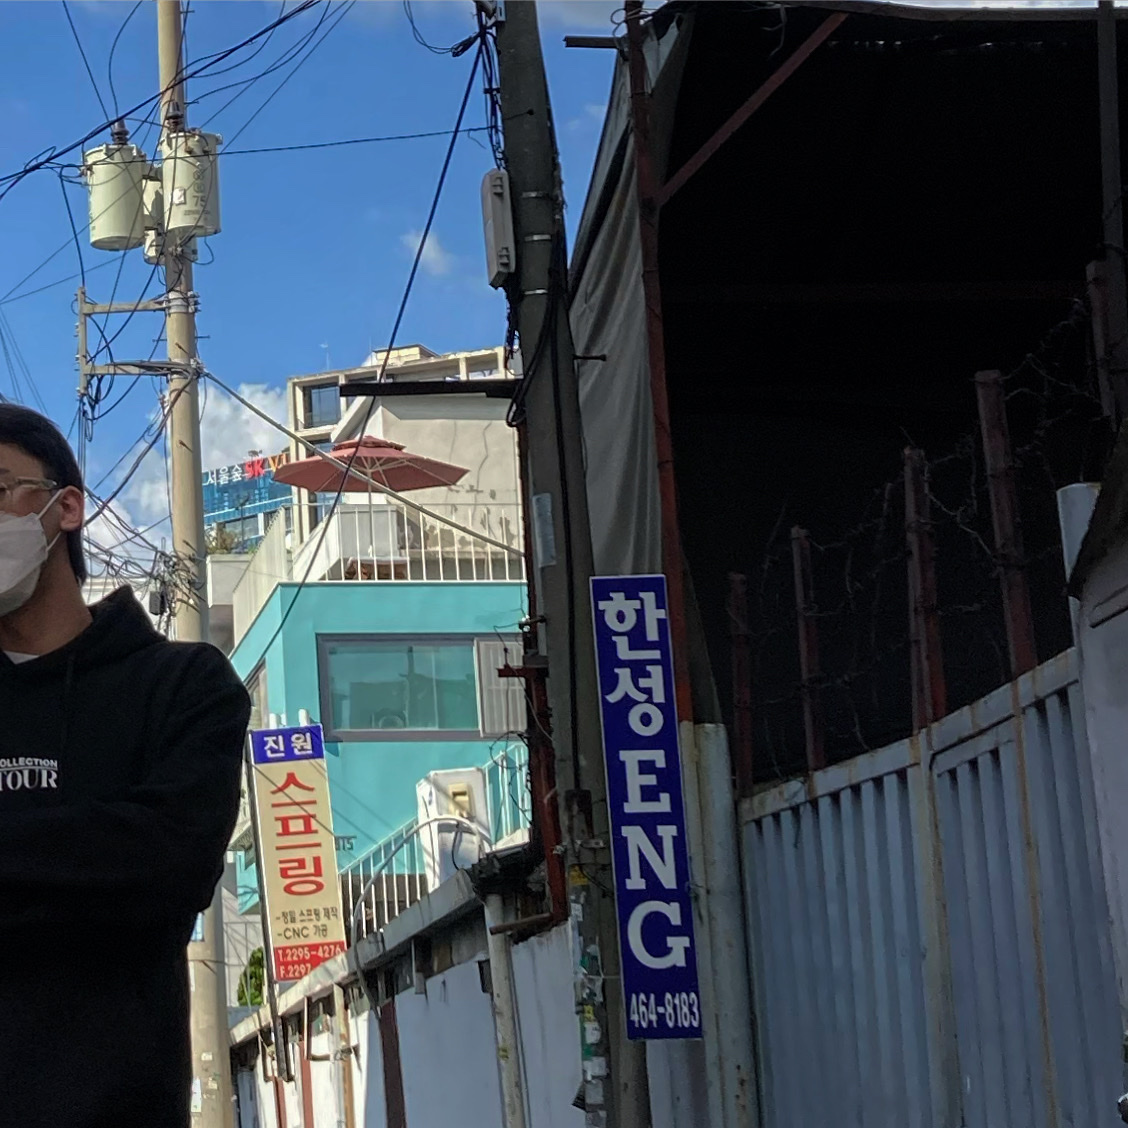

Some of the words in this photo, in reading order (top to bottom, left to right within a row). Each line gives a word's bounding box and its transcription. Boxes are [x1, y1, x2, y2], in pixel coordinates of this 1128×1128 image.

[207, 464, 242, 486] 서울숲
[245, 459, 264, 478] SK
[263, 732, 313, 758] 진원
[270, 772, 325, 896] 스프링
[299, 908, 321, 922] 스프링
[323, 906, 338, 920] 제작
[313, 924, 328, 938] 가공
[630, 991, 700, 1031] 464-8183
